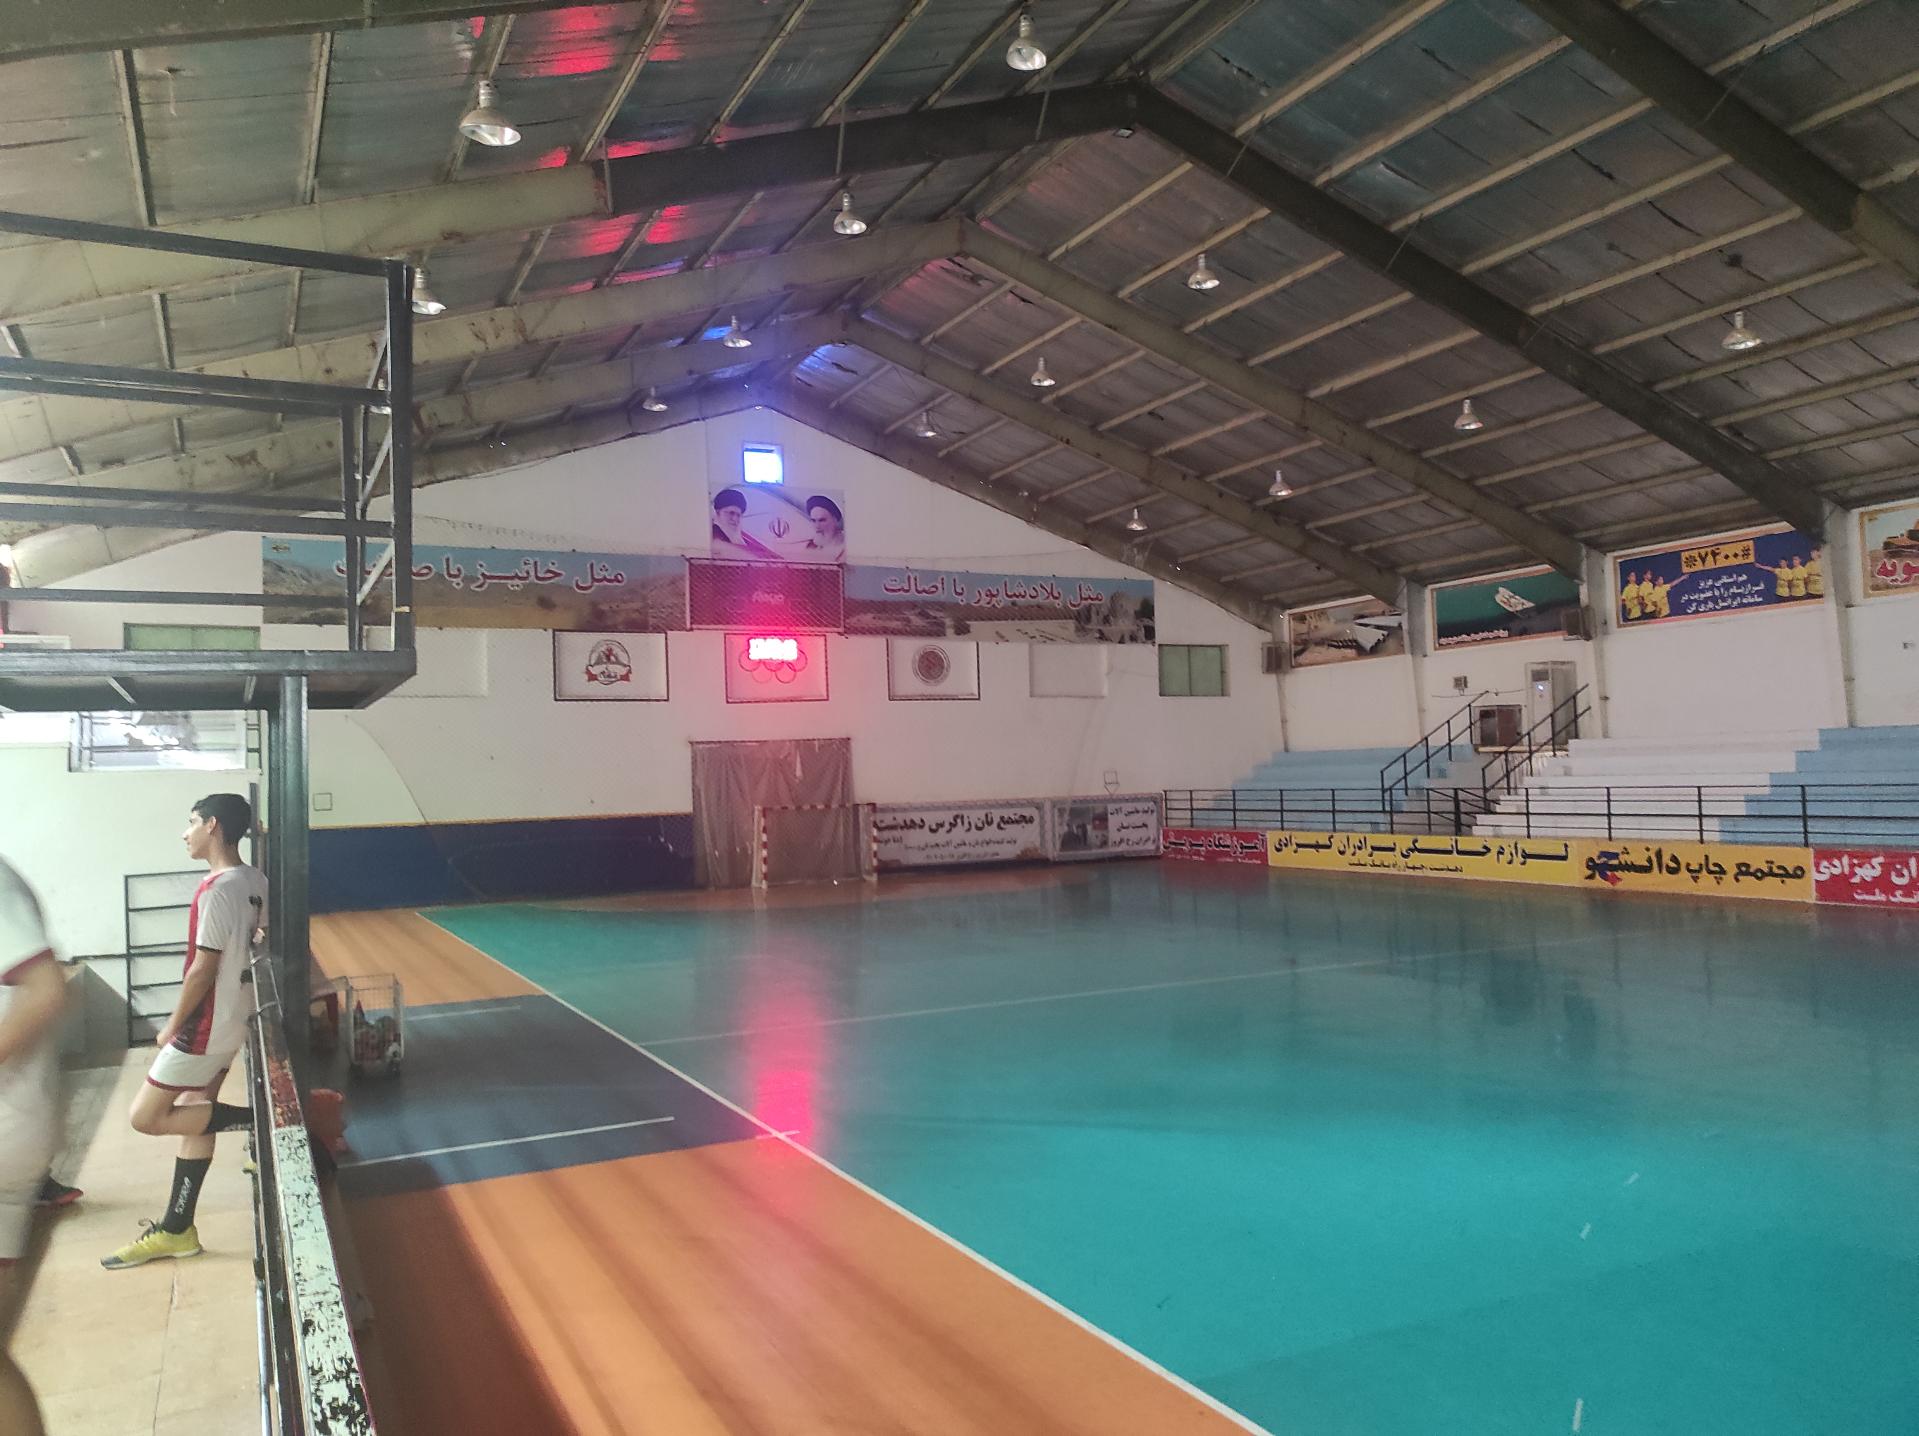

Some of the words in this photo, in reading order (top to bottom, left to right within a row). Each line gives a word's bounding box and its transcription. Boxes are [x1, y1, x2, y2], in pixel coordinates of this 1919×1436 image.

[443, 555, 463, 589] با
[574, 560, 625, 593] مثل
[882, 574, 946, 597] اصالت
[951, 576, 966, 604] با
[1068, 582, 1105, 608] مثل
[1337, 835, 1397, 857] برادران
[1400, 838, 1492, 859] خانگی
[1496, 840, 1569, 865] لوازم
[1584, 846, 1681, 885] دانشجو
[1685, 854, 1727, 885] چاپ
[1734, 859, 1806, 884] مجتمع
